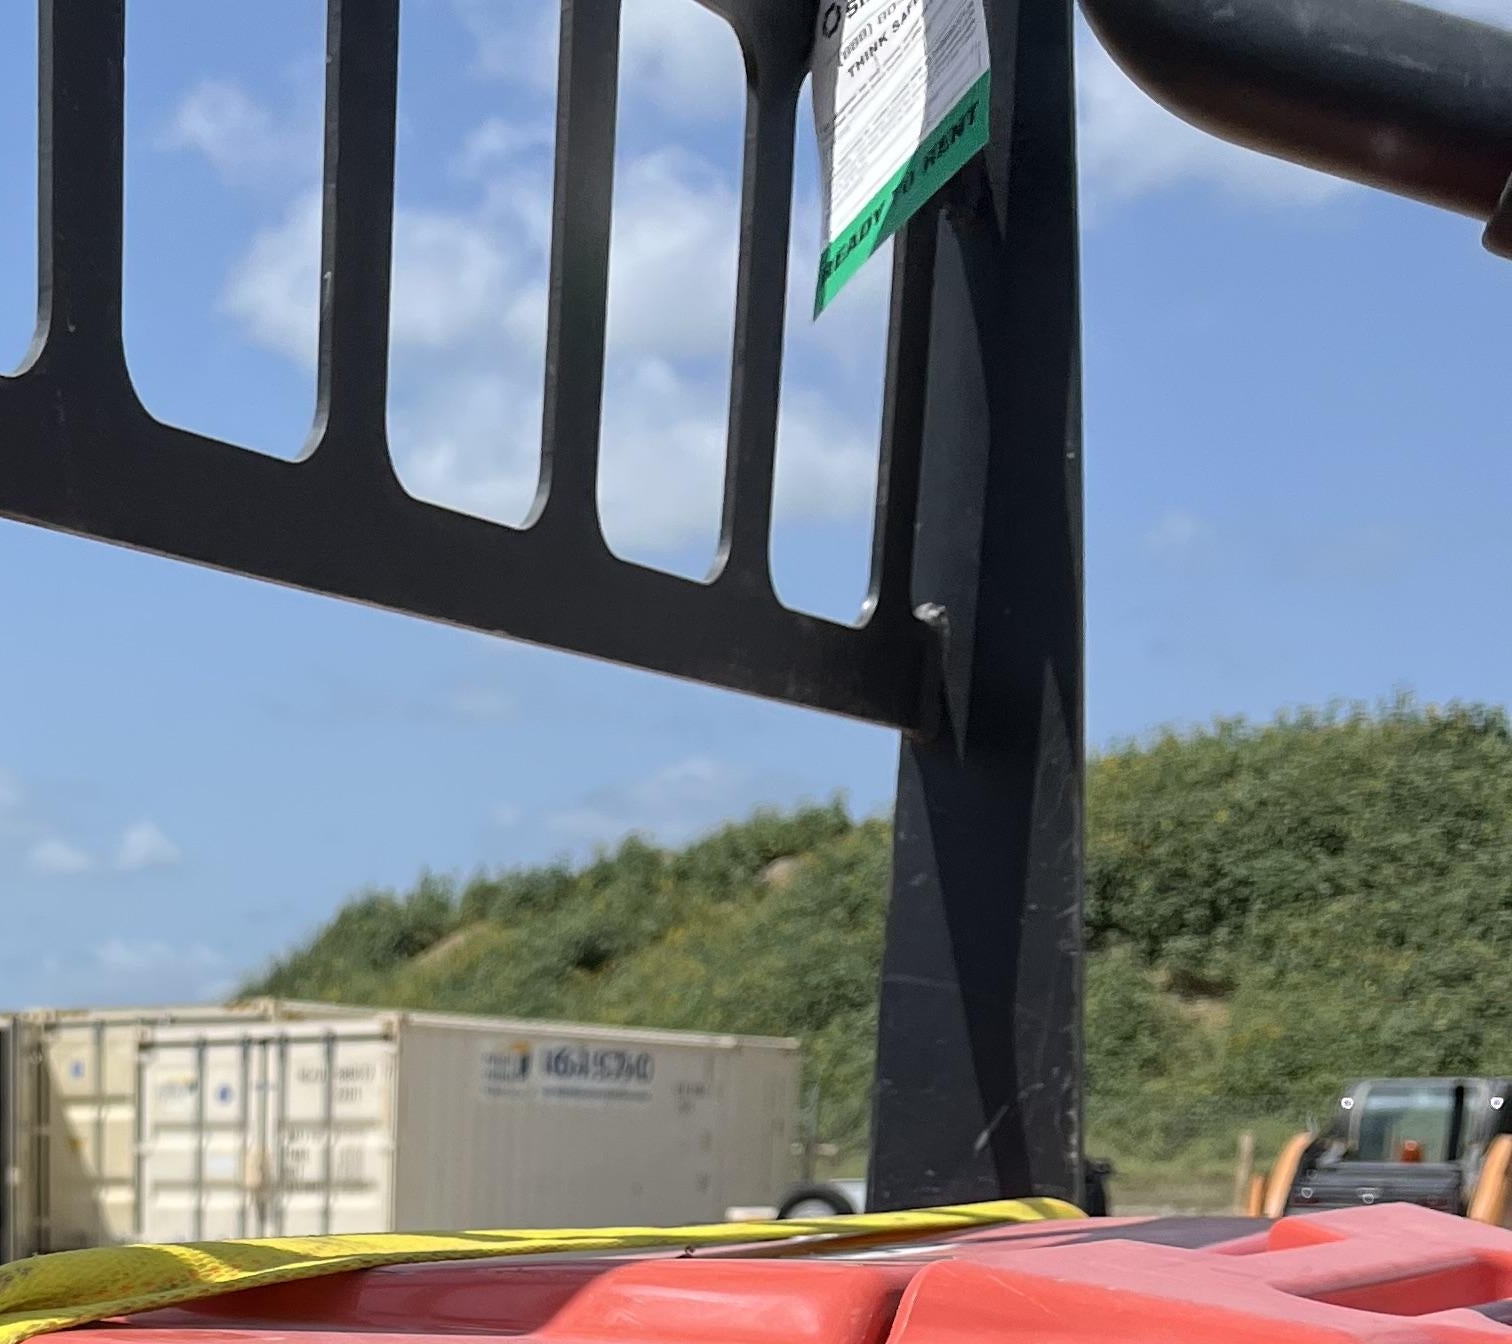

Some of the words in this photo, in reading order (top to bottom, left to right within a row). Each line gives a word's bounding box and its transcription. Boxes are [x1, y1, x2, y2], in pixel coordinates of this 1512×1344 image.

[847, 32, 888, 78] THINK
[820, 203, 885, 282] READY
[922, 100, 980, 174] RENT
